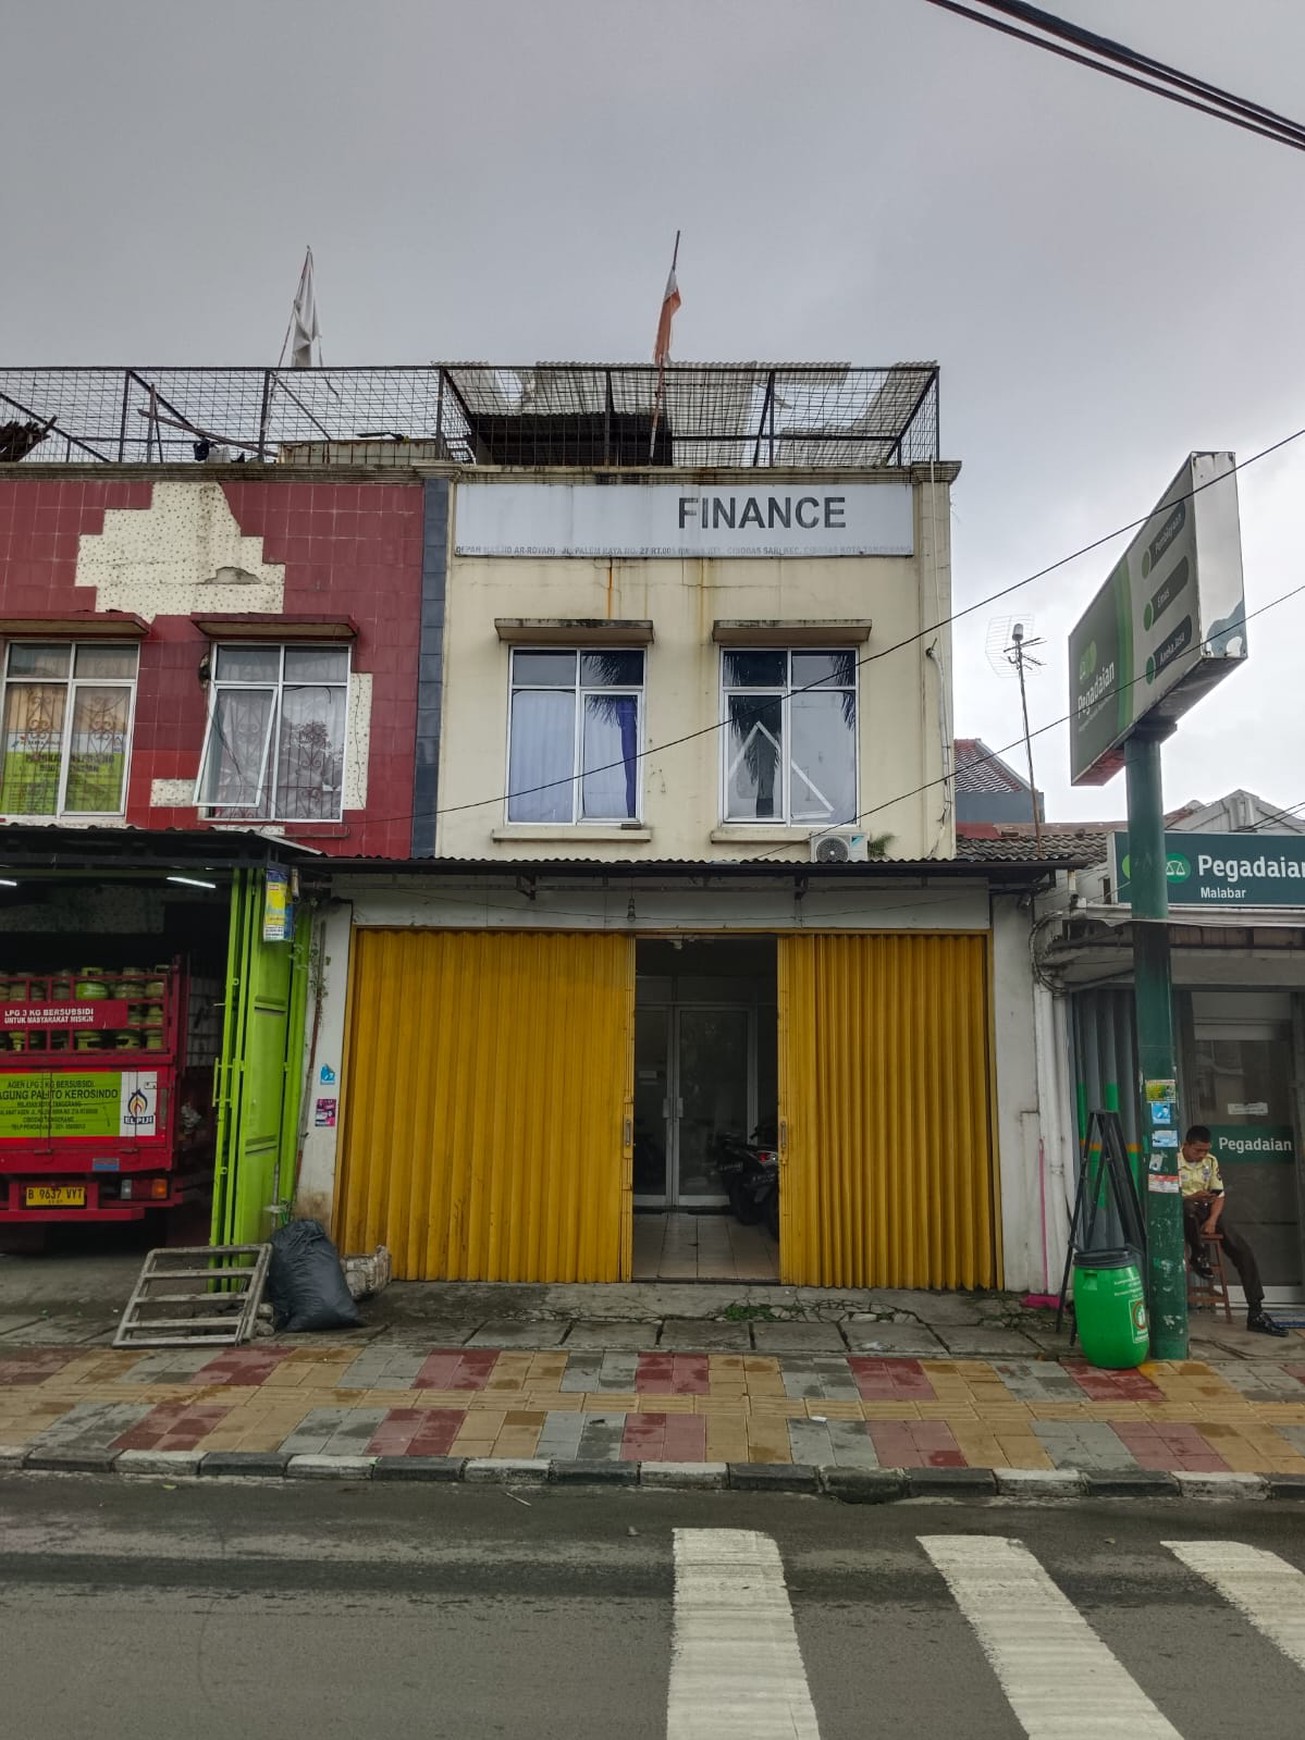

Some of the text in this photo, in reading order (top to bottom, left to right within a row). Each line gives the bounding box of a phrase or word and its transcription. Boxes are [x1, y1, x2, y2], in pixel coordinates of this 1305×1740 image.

[678, 496, 847, 529] FINANCE
[1078, 661, 1115, 719] Pegadaian
[1200, 887, 1247, 899] Malabar
[5, 1009, 20, 1017] LPG
[43, 1008, 94, 1016] BERSUBSIDI
[27, 1016, 69, 1024] MASYARAKAT
[65, 1088, 118, 1099] KEROSINDO
[125, 1116, 153, 1124] ELPIJI
[1219, 1137, 1292, 1154] Pegadaian
[28, 1189, 83, 1199] B 9637 VYT
